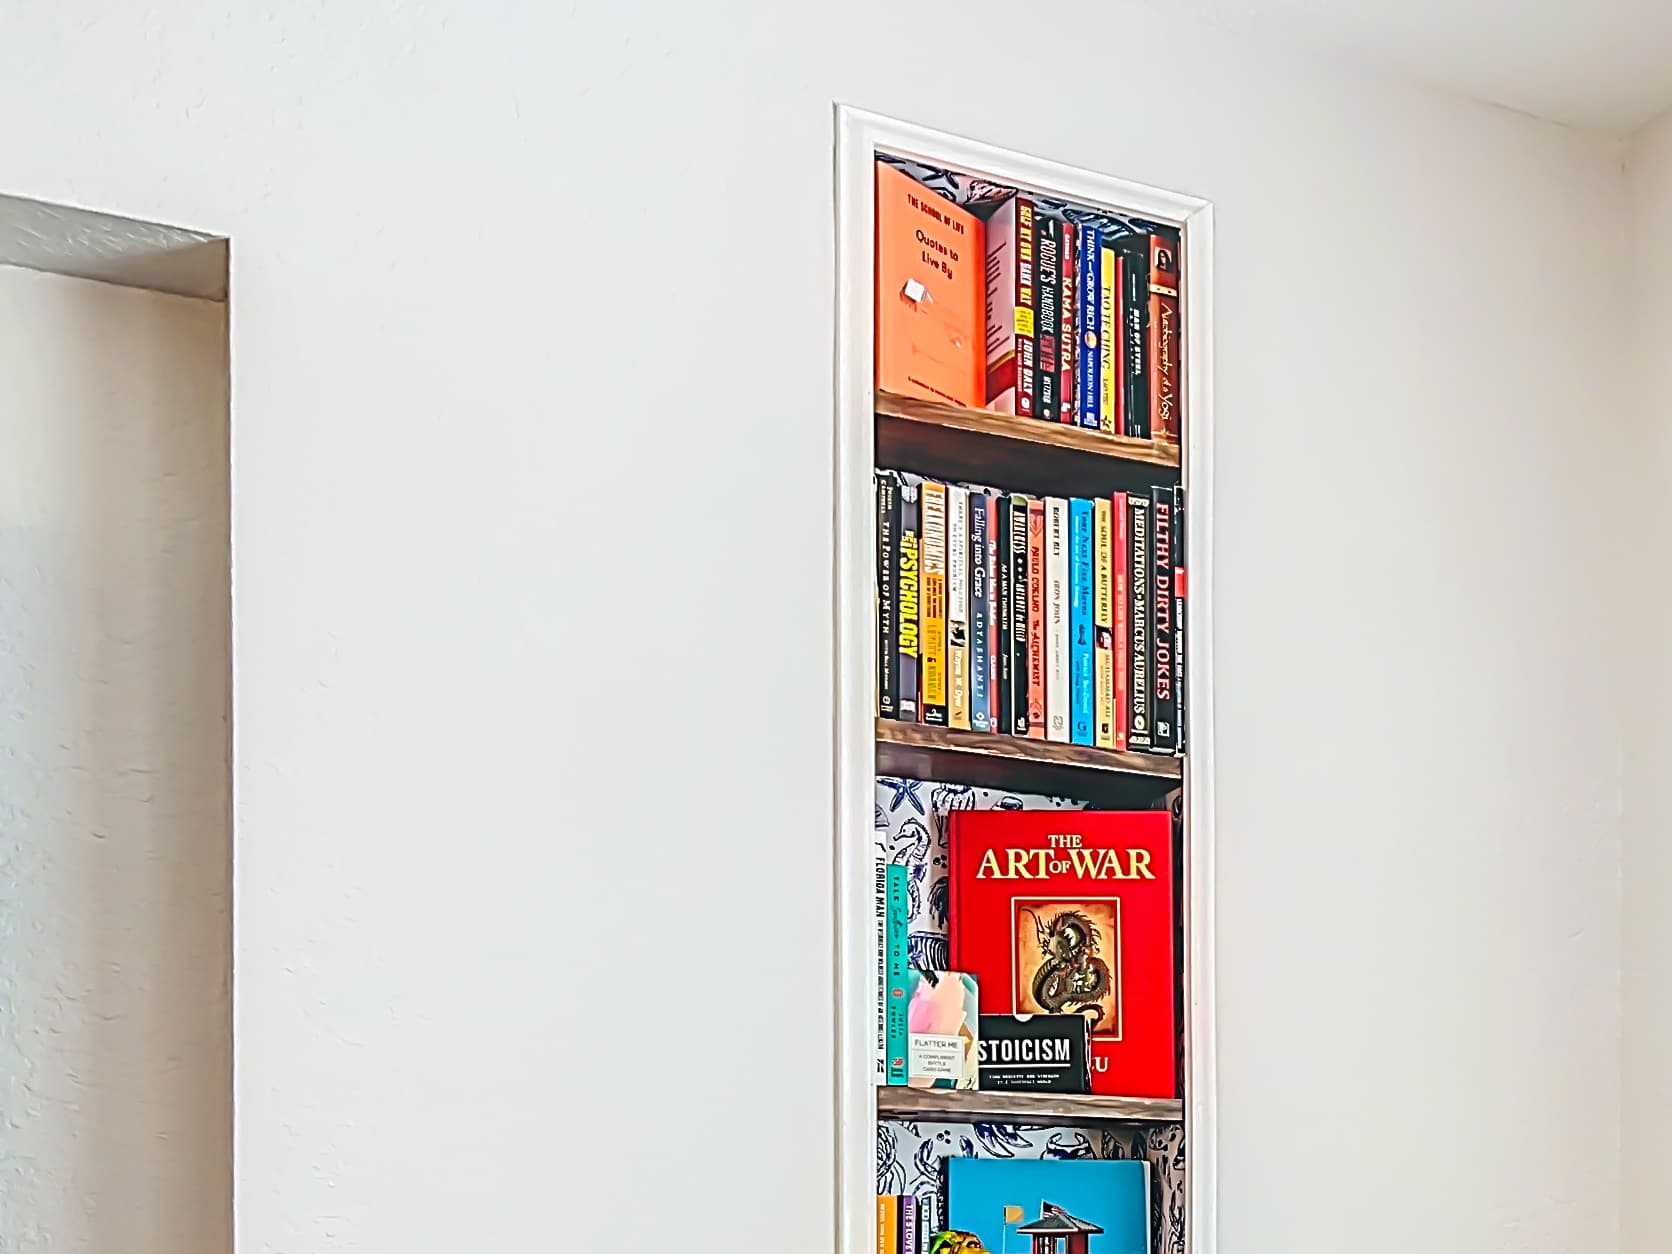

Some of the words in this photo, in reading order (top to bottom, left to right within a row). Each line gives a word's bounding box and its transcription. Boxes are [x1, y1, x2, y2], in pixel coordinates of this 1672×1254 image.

[908, 194, 918, 208] THE
[921, 202, 942, 222] SCHOOL
[953, 220, 964, 234] LIFE
[916, 230, 947, 255] Quotes
[950, 250, 958, 261] to
[1040, 238, 1056, 285] ROGUE'S
[1086, 230, 1095, 261] THINK
[922, 251, 939, 269] Live
[942, 262, 952, 280] By
[1062, 277, 1071, 320] KAMA
[1086, 272, 1094, 304] GROW
[1102, 286, 1111, 310] TAO
[1041, 286, 1054, 334] HANDBOOK
[1086, 305, 1094, 330] RICH
[1024, 339, 1033, 367] JOHN
[1061, 323, 1070, 372] SUTRA
[1102, 327, 1111, 369] CHING
[1158, 303, 1172, 375] Autobiography
[1024, 369, 1033, 395] DALY
[1159, 393, 1172, 420] Yogi
[970, 508, 984, 542] Falling
[1014, 511, 1027, 554] AWARENESS
[1080, 511, 1089, 532] Your
[1156, 503, 1169, 569] FILTHY
[974, 544, 984, 564] into
[1031, 546, 1040, 574] PAULO
[1081, 536, 1089, 558] Next
[1134, 508, 1145, 595] MEDITATIONS
[882, 546, 891, 582] POWER
[882, 585, 890, 598] OF
[974, 568, 985, 598] Grace
[1032, 578, 1040, 613] COELHO
[1100, 574, 1108, 623] BUTTERFLY
[882, 600, 890, 634] MYTH
[899, 549, 918, 658] PSYCHOLOGY
[1156, 575, 1169, 634] DIRTY
[1134, 600, 1145, 650] MARCUS
[1031, 632, 1040, 686] ALCHEMIST
[1156, 638, 1170, 700] JOKES
[1133, 652, 1145, 714] AURELIUS
[1048, 835, 1082, 848] THE
[876, 857, 884, 894] FLORIDA
[977, 849, 1054, 879] ART
[1050, 861, 1070, 874] OF
[1068, 849, 1155, 879] WAR
[876, 897, 884, 918] MAN
[894, 945, 899, 957] TO
[894, 964, 899, 976] ME
[915, 1039, 946, 1048] FLATTER
[979, 1039, 1070, 1061] STOICISM
[905, 1229, 913, 1249] LOVE
